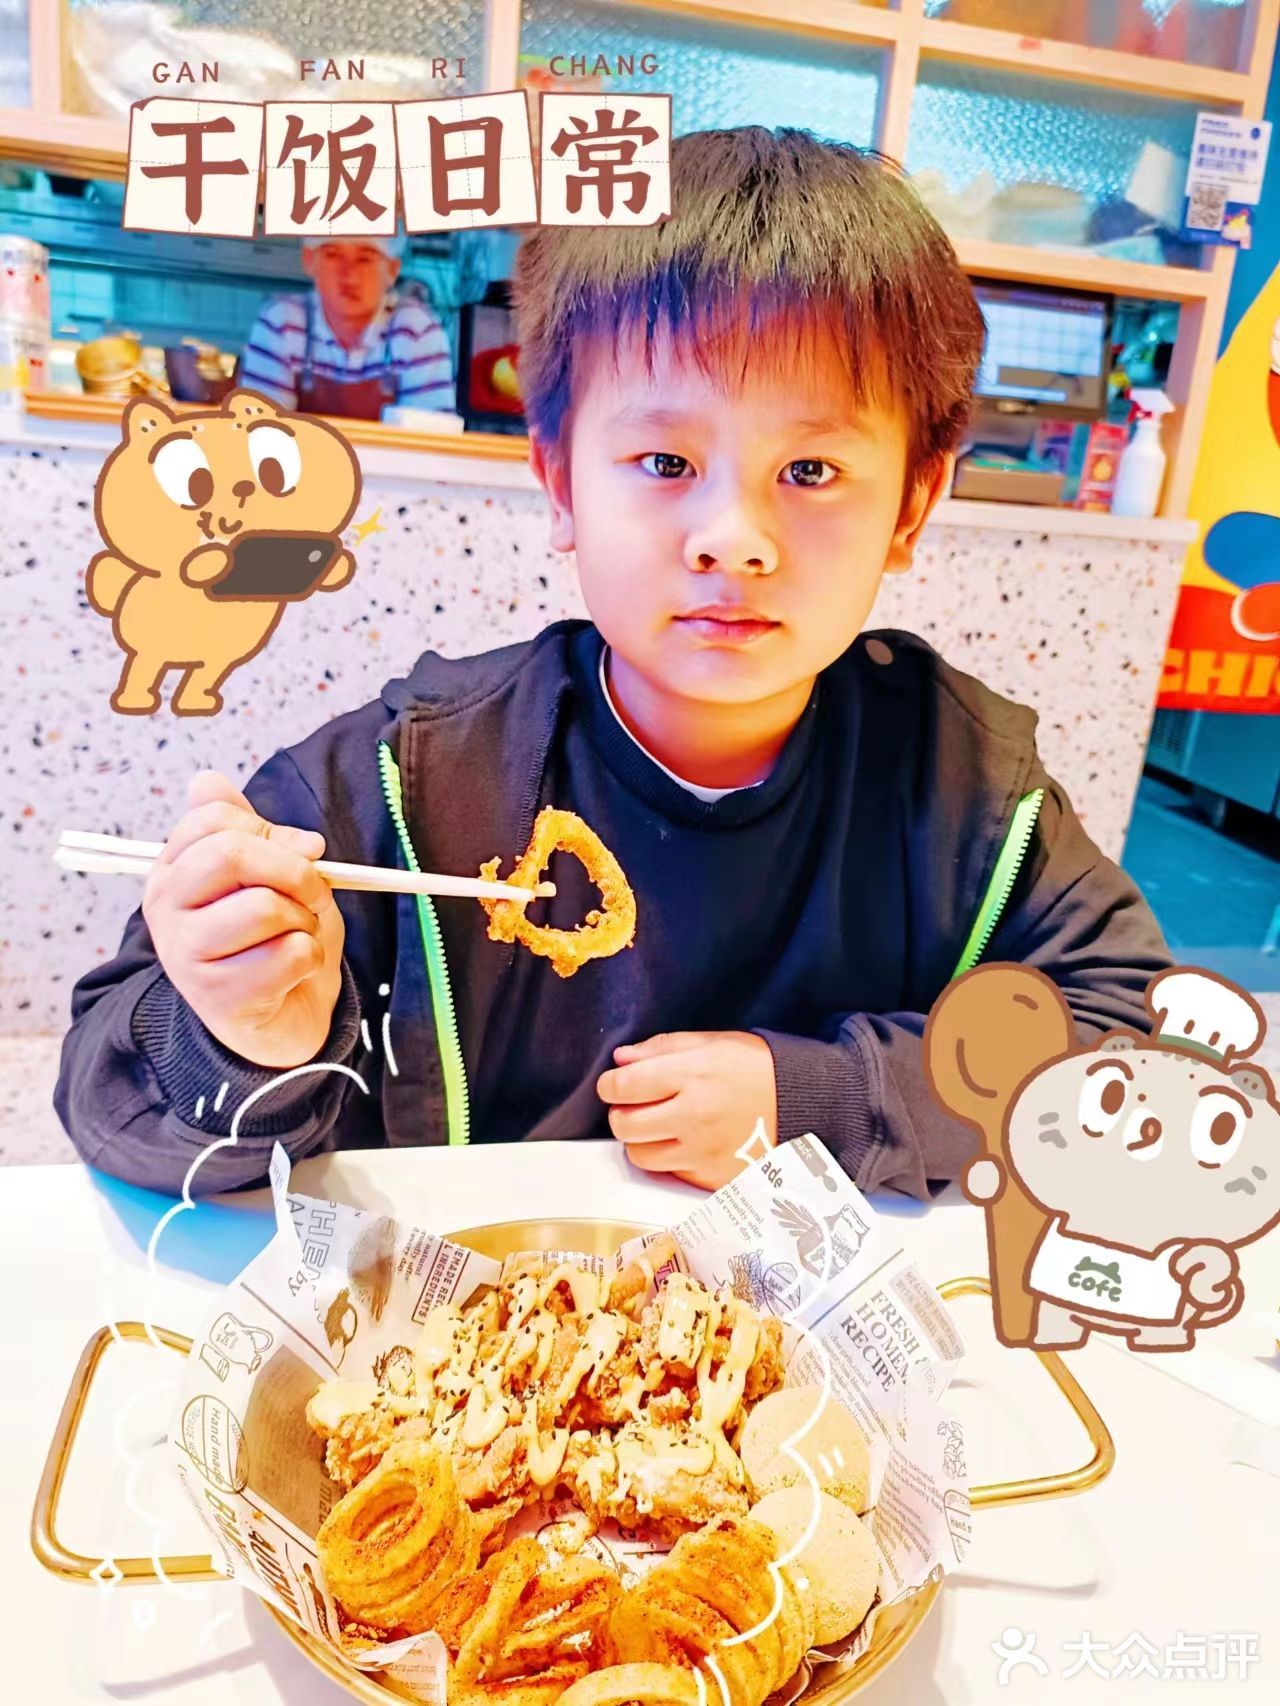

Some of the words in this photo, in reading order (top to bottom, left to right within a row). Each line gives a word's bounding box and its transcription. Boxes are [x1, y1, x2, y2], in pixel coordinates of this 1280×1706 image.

[1157, 647, 1280, 698] CHI
[760, 1157, 785, 1190] ade
[288, 1271, 307, 1297] by
[417, 1252, 449, 1318] INGREDIENTS
[442, 1247, 464, 1284] EMADE
[869, 1289, 920, 1355] FRESH
[839, 1314, 897, 1392] RECIPE
[210, 1406, 223, 1447] Hand
